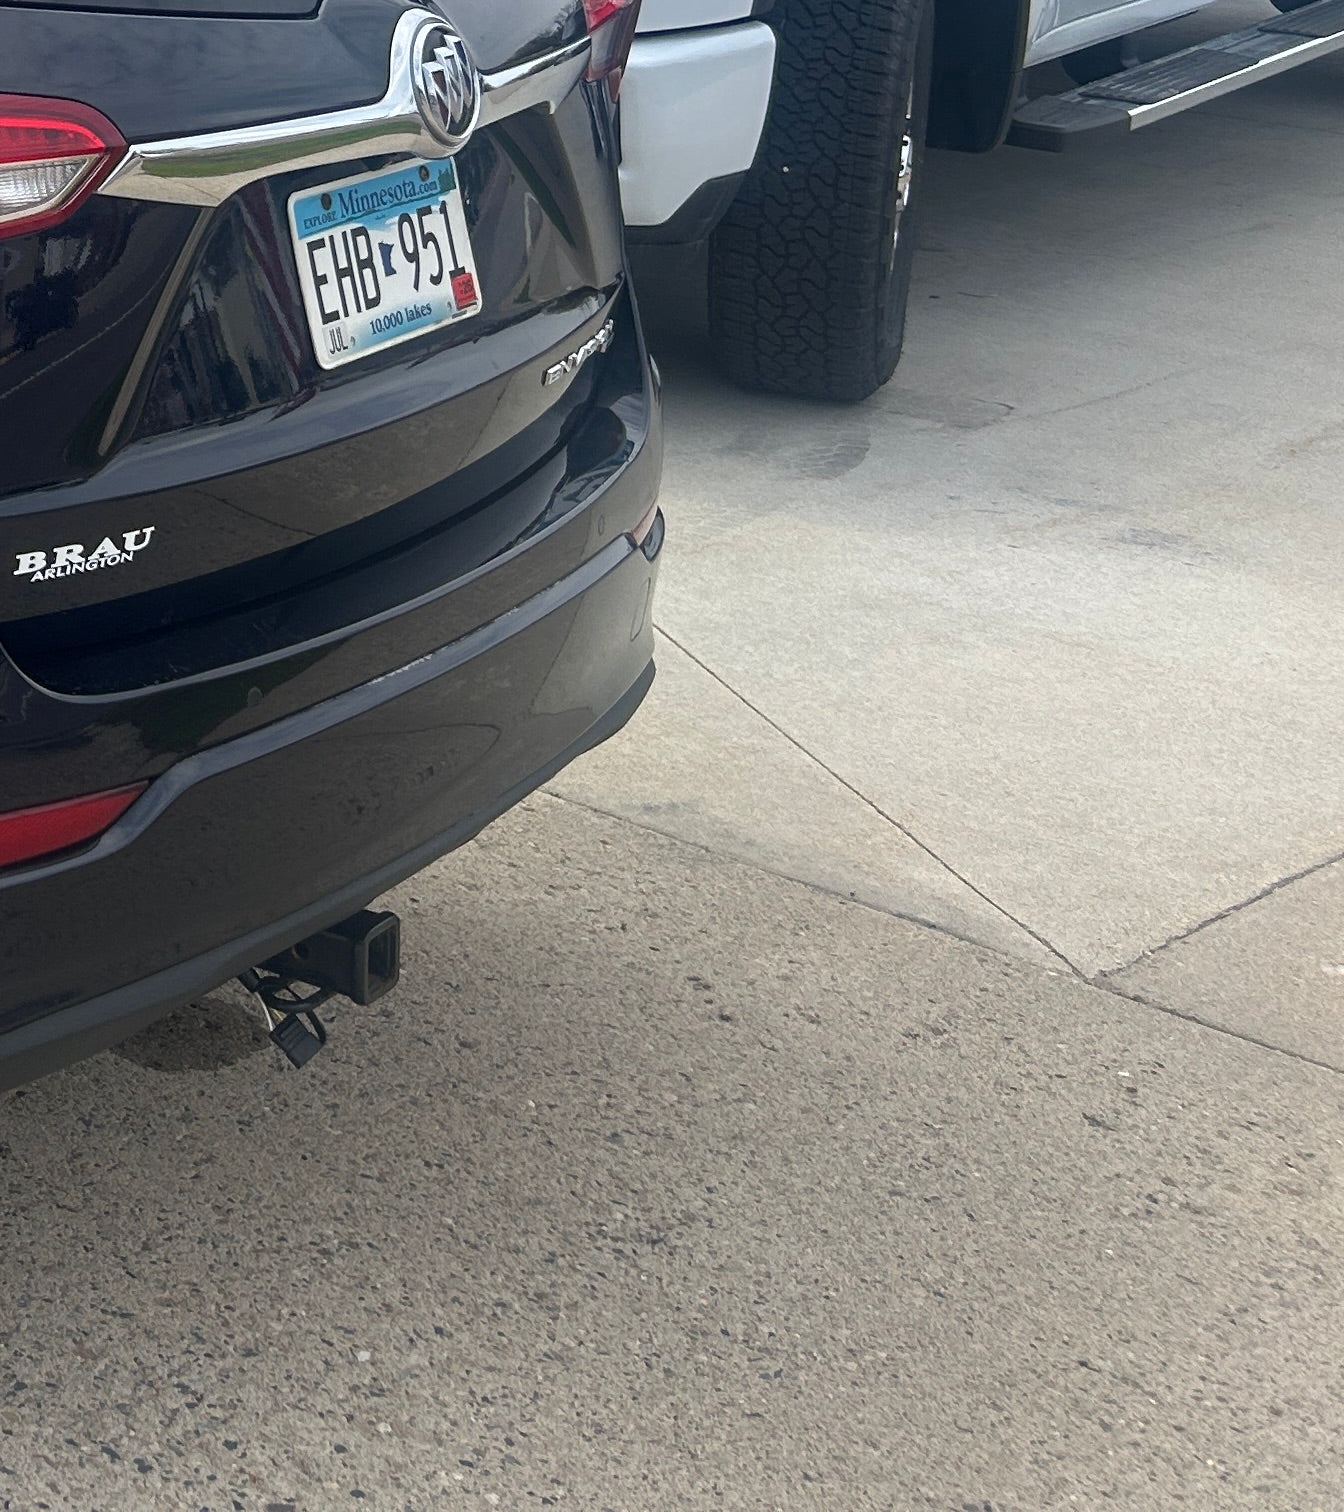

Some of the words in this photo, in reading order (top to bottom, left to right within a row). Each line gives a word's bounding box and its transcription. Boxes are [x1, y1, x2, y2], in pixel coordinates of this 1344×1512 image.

[303, 210, 337, 230] EXPLORE
[306, 225, 381, 325] EHB
[397, 201, 466, 293] 951
[370, 312, 404, 336] 10,000
[407, 301, 433, 323] lakes
[328, 325, 349, 355] JUL
[13, 526, 156, 575] BRAU
[30, 551, 134, 583] ARLINGTON
